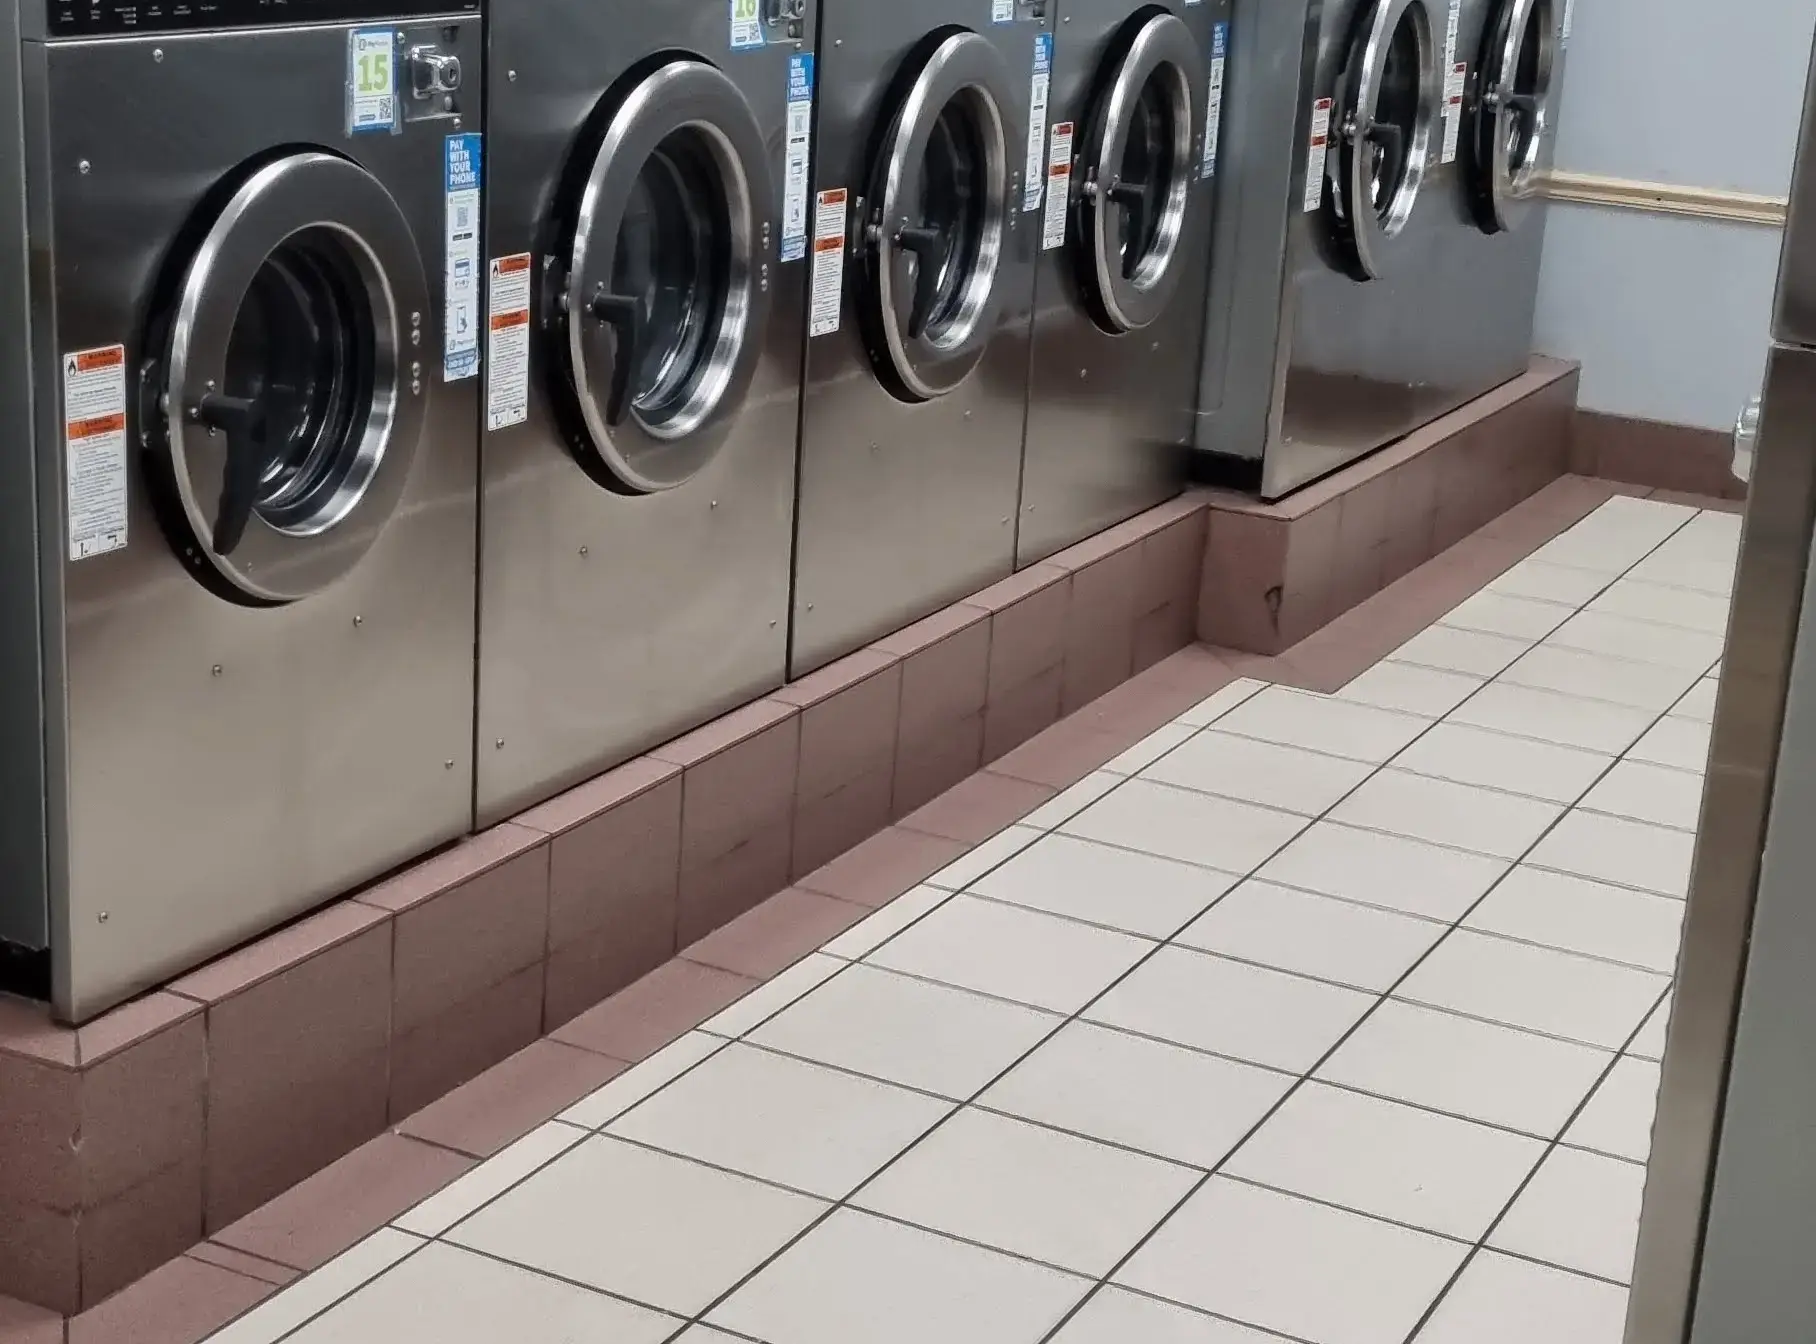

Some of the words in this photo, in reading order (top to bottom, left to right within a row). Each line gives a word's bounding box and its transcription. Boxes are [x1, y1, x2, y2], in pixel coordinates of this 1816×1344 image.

[358, 55, 388, 91] 15
[449, 139, 464, 151] PAY
[449, 150, 469, 163] WITH
[449, 161, 471, 174] YOUR
[449, 172, 476, 186] PHONE
